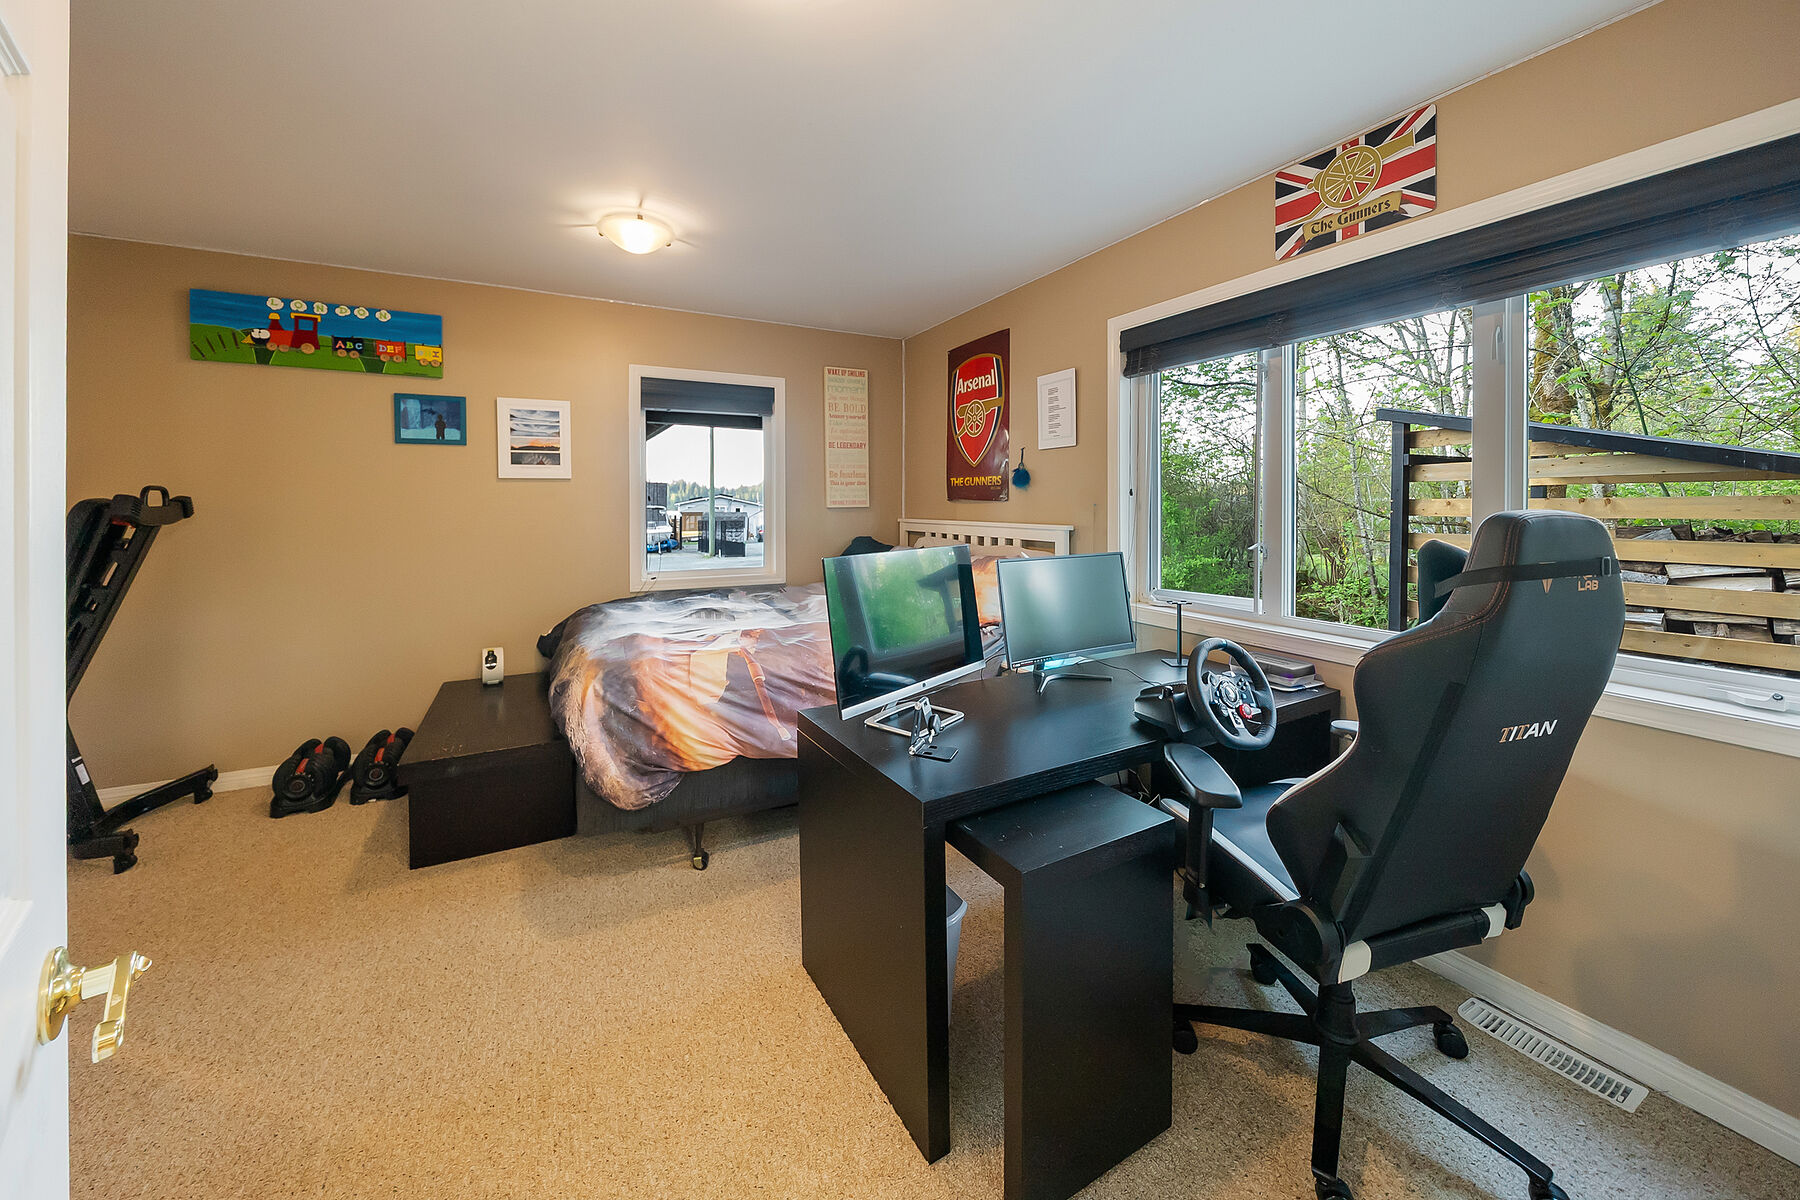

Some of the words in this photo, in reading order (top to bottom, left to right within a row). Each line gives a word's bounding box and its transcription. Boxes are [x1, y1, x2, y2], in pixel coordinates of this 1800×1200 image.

[1310, 219, 1334, 235] The
[1337, 199, 1391, 226] Gunners
[270, 299, 388, 320] LONDON
[335, 340, 363, 350] ABC
[378, 344, 402, 354] DEF
[956, 369, 996, 395] Arsenal
[828, 402, 840, 412] BE
[843, 403, 867, 413] BOLD
[828, 441, 836, 449] BE
[836, 441, 867, 449] LEGENDARY
[950, 477, 964, 487] THE
[964, 475, 1002, 487] GUNNERS
[1577, 579, 1599, 592] LAB
[1499, 719, 1558, 743] TITAN
